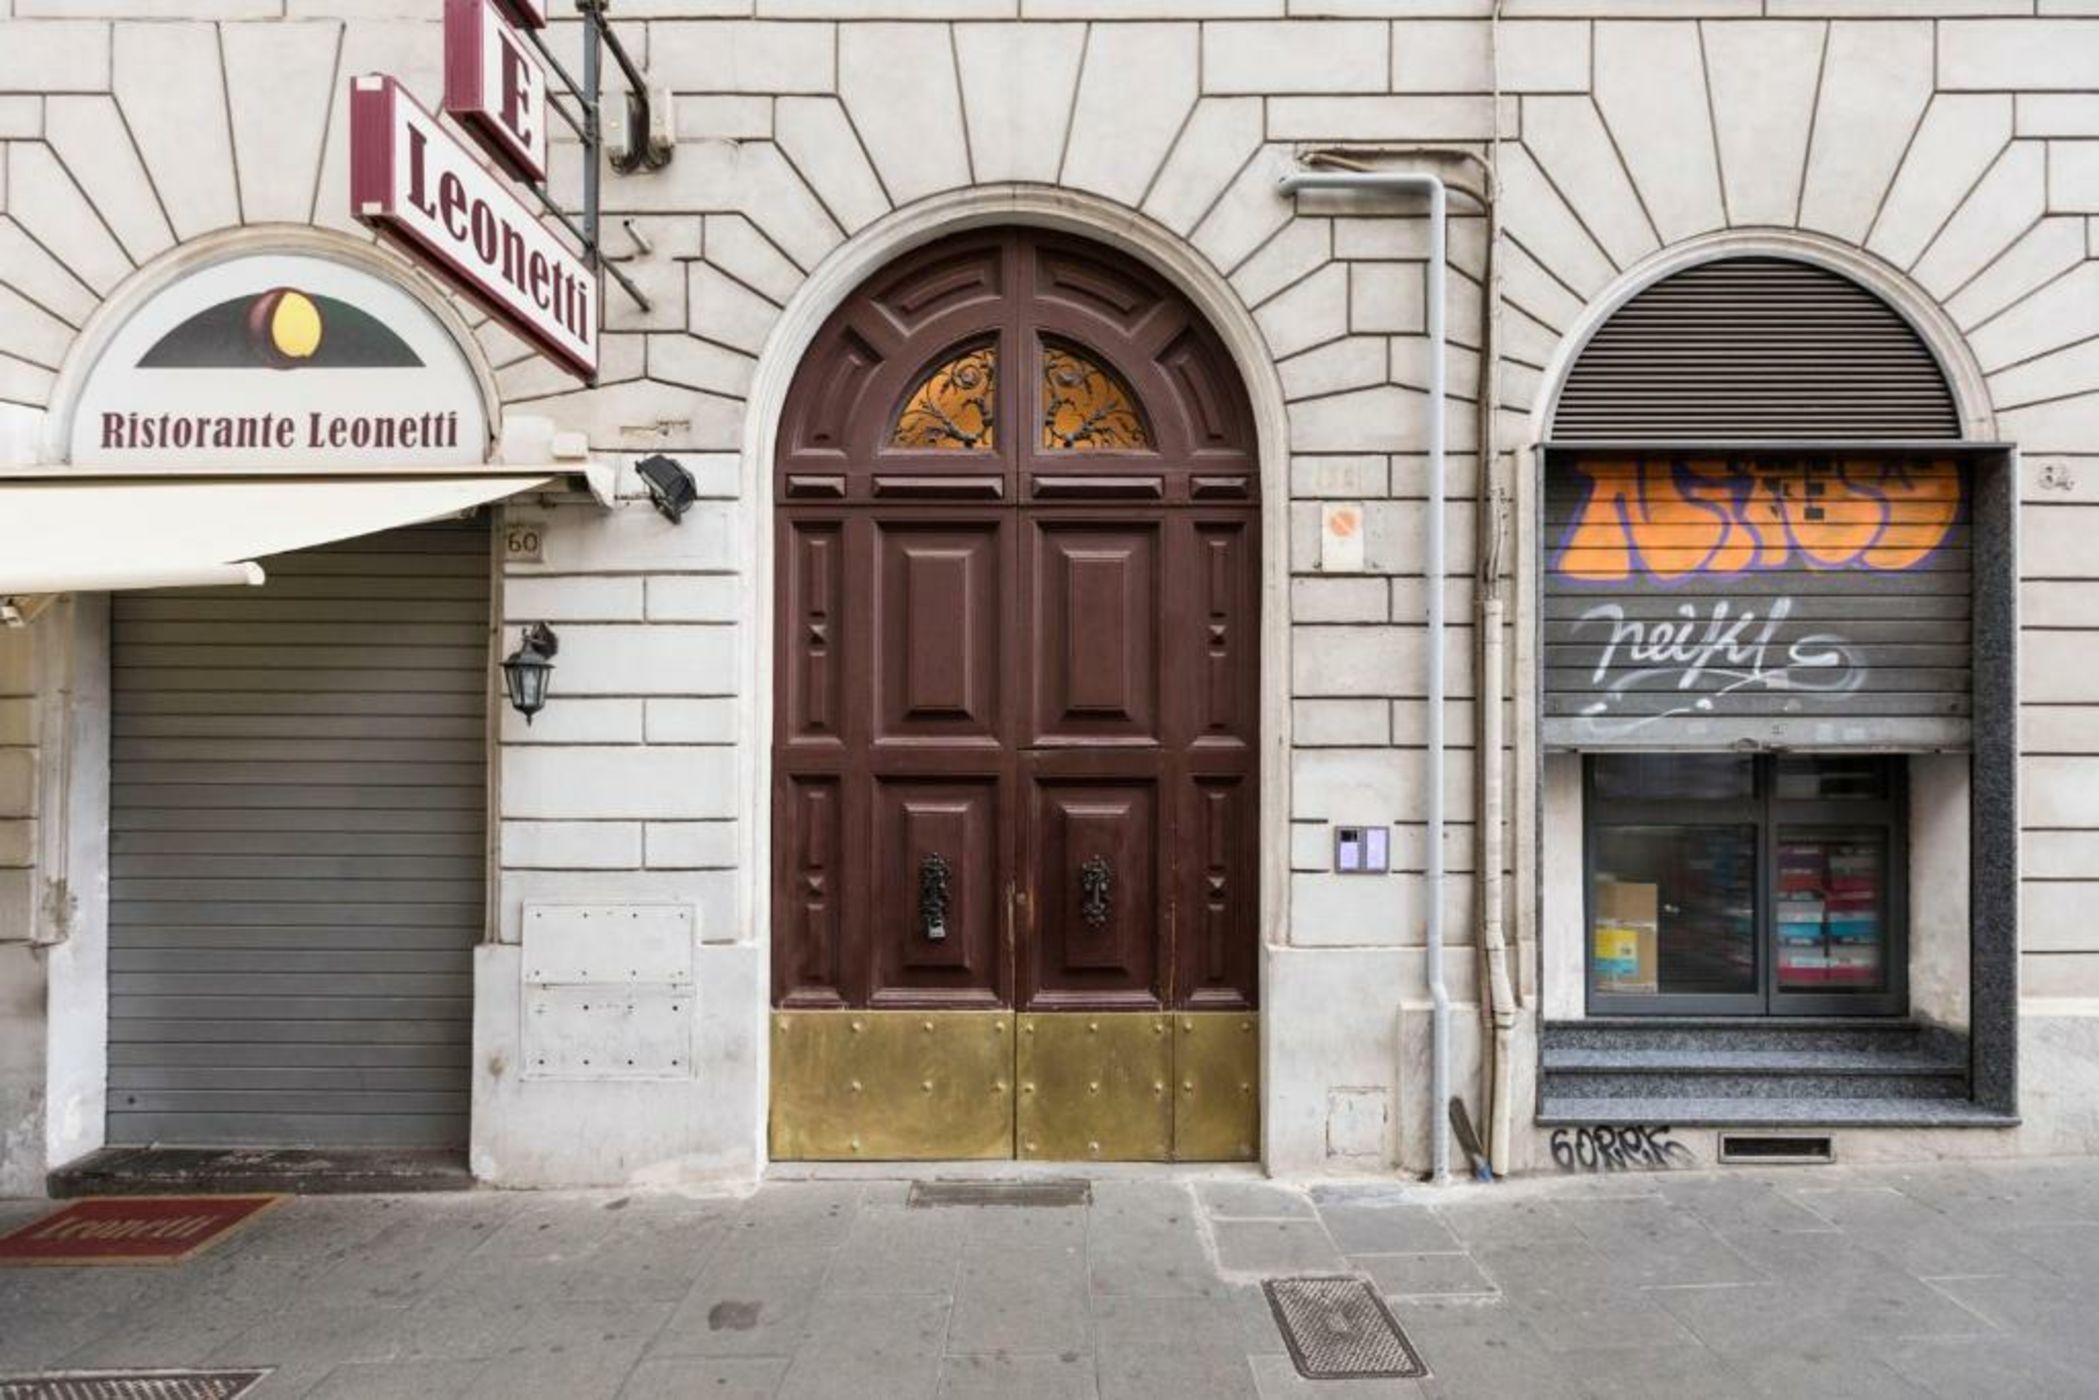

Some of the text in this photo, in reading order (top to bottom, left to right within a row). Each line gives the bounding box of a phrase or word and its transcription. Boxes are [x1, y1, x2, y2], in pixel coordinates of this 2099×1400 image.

[499, 28, 532, 149] E
[407, 121, 589, 346] Leonetti
[101, 411, 458, 449] Ristorante Leonetti
[508, 532, 538, 552] 60
